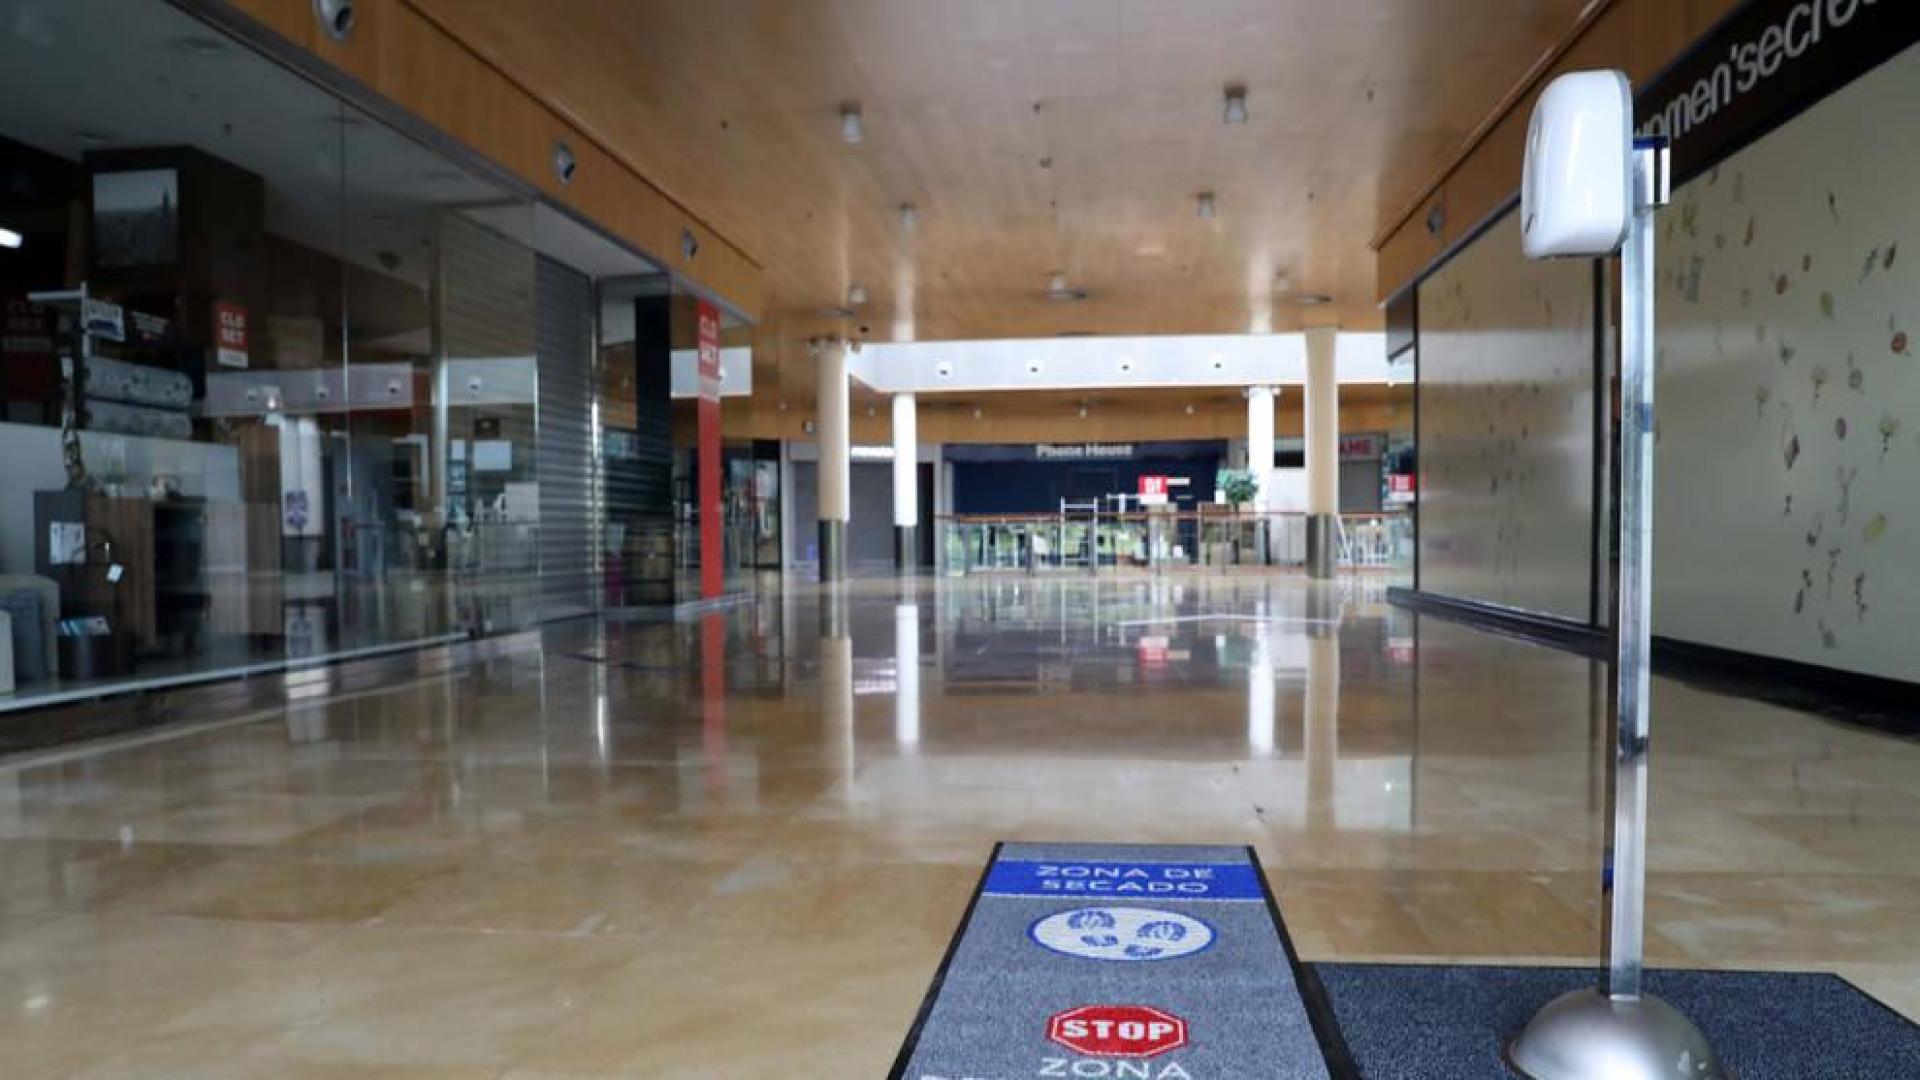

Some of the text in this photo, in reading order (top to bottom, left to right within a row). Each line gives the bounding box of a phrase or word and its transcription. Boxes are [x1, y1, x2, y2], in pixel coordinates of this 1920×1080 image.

[1036, 865, 1214, 880] ZONA DE
[1042, 879, 1208, 893] SECADO
[1063, 1019, 1174, 1040] STOP
[1039, 1058, 1193, 1080] ZONA
